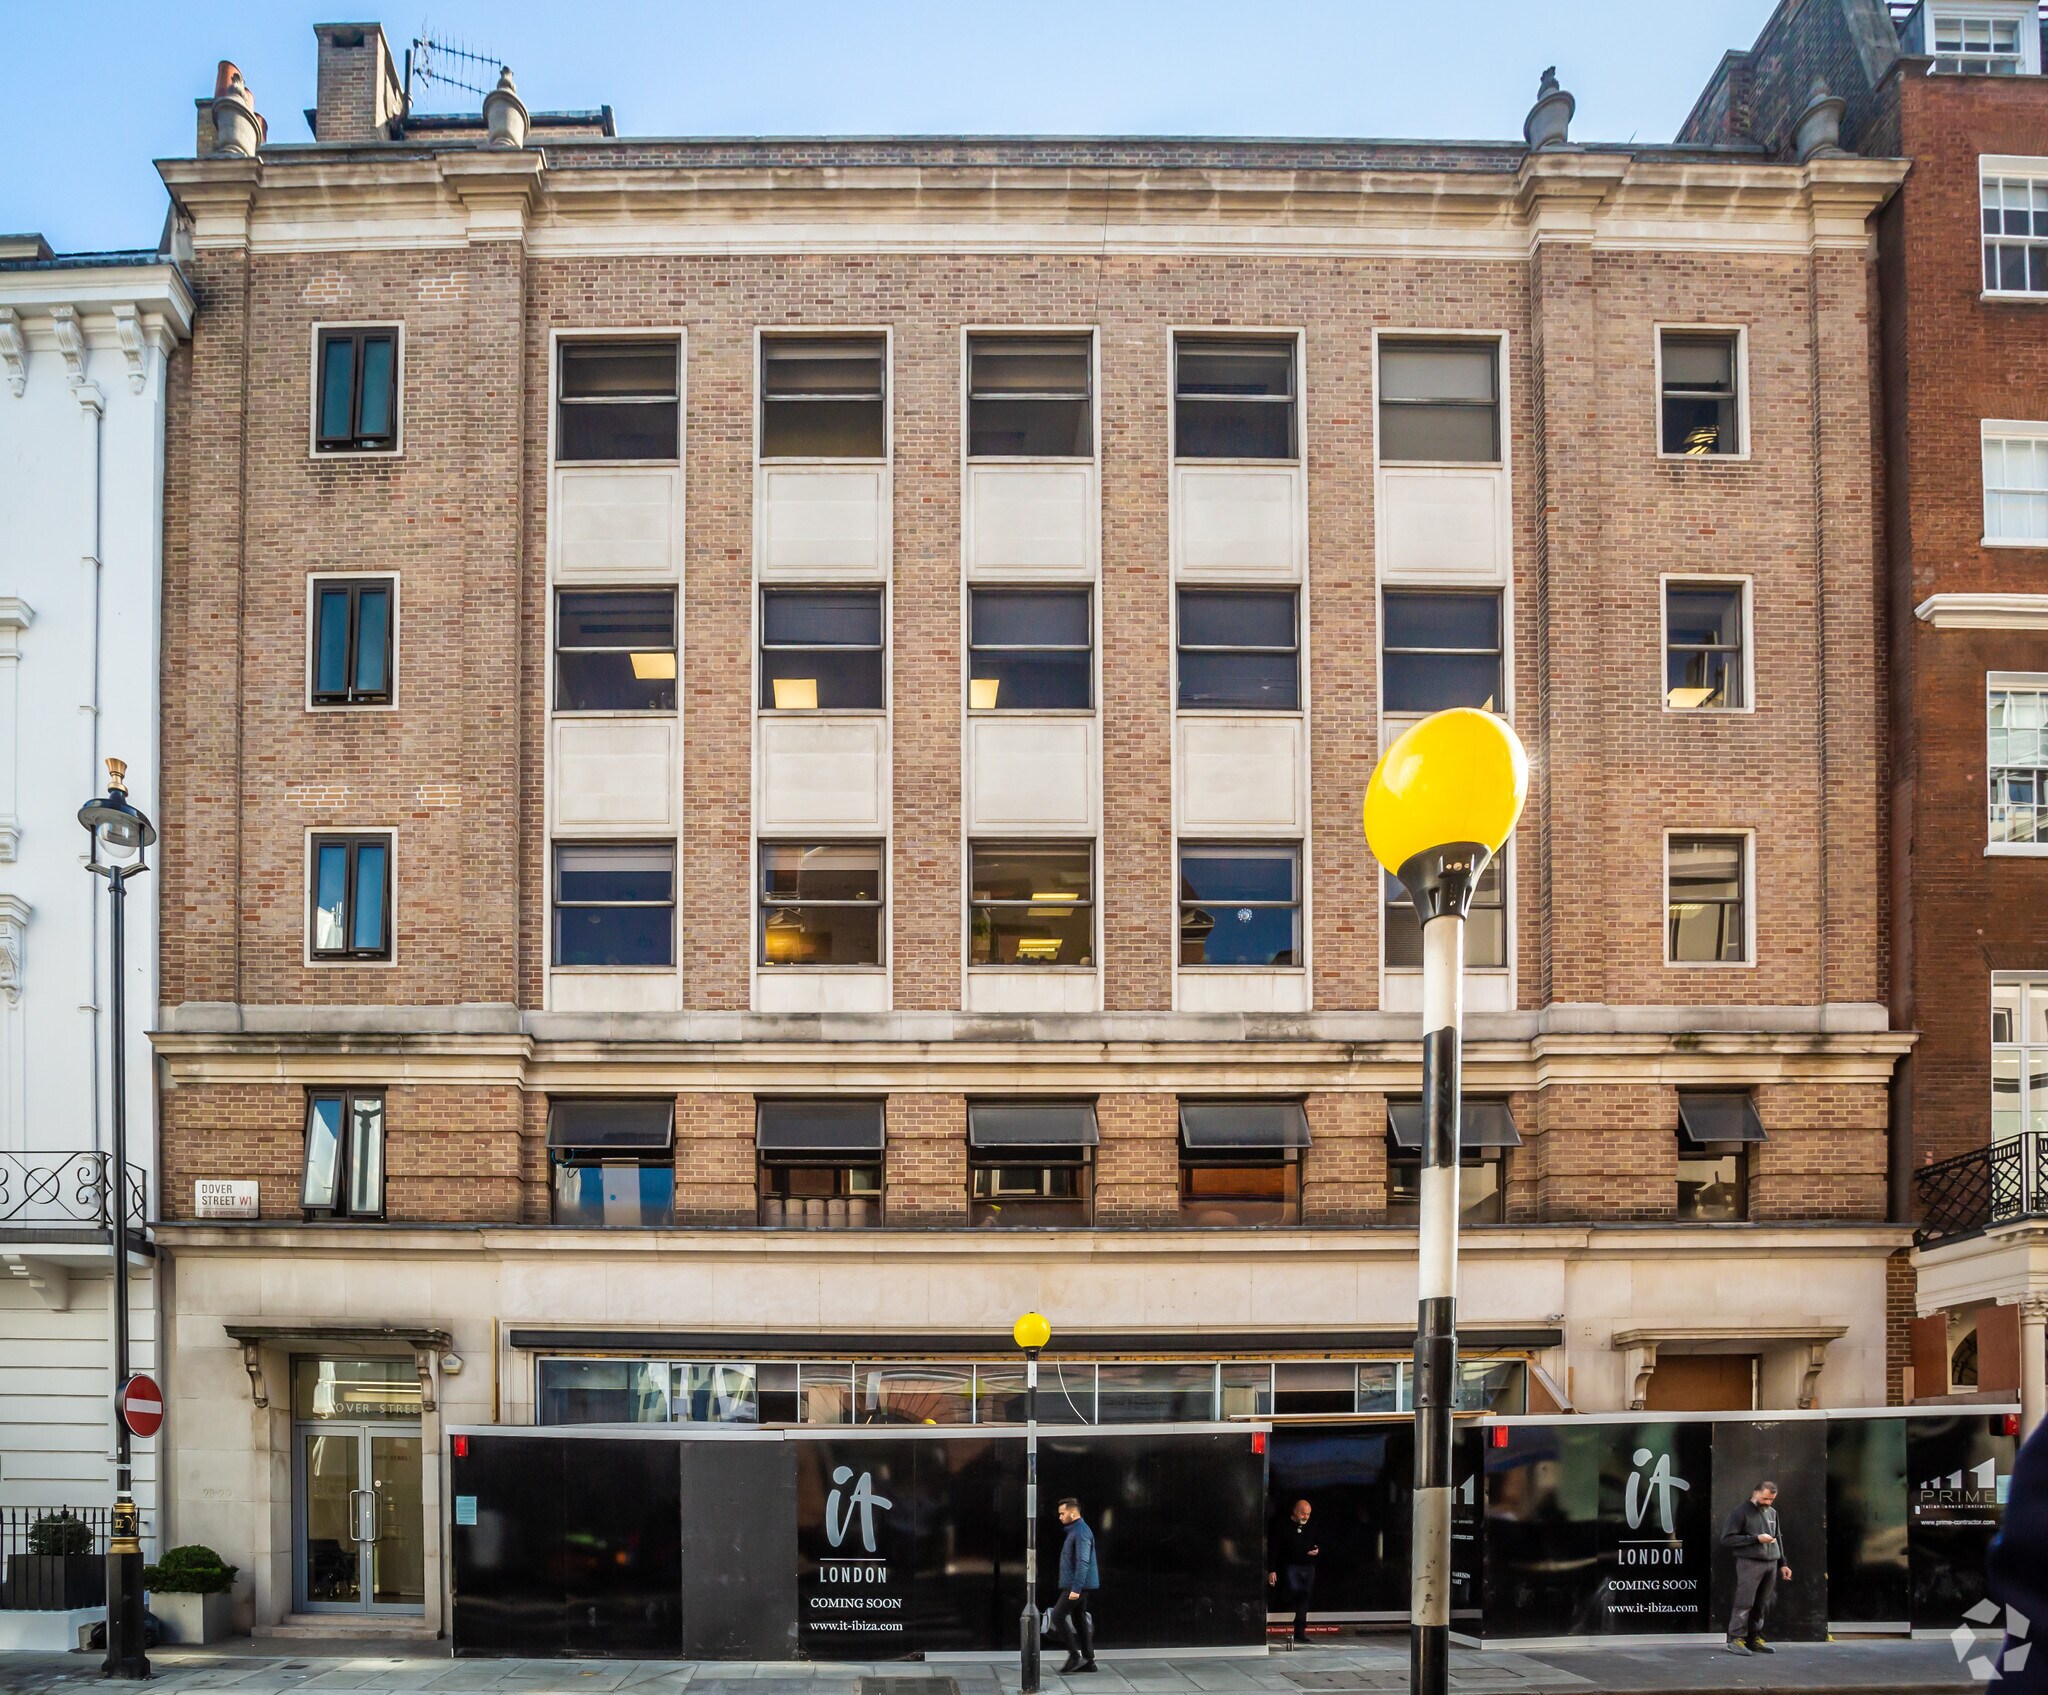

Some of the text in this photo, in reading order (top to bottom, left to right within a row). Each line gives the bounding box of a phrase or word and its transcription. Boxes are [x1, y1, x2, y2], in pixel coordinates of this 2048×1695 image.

[202, 1184, 232, 1194] DOVER
[202, 1196, 252, 1206] STREET W1
[335, 1402, 422, 1414] OVER STREE
[1920, 1490, 1996, 1503] PRIME
[1618, 1548, 1683, 1565] LONDON
[819, 1566, 887, 1584] LONDON
[1608, 1579, 1698, 1591] COMING SOON
[810, 1598, 902, 1609] COMING SOON
[1607, 1602, 1698, 1613] www.it-ibiza.com
[810, 1620, 903, 1631] www.it-ibiza.com
